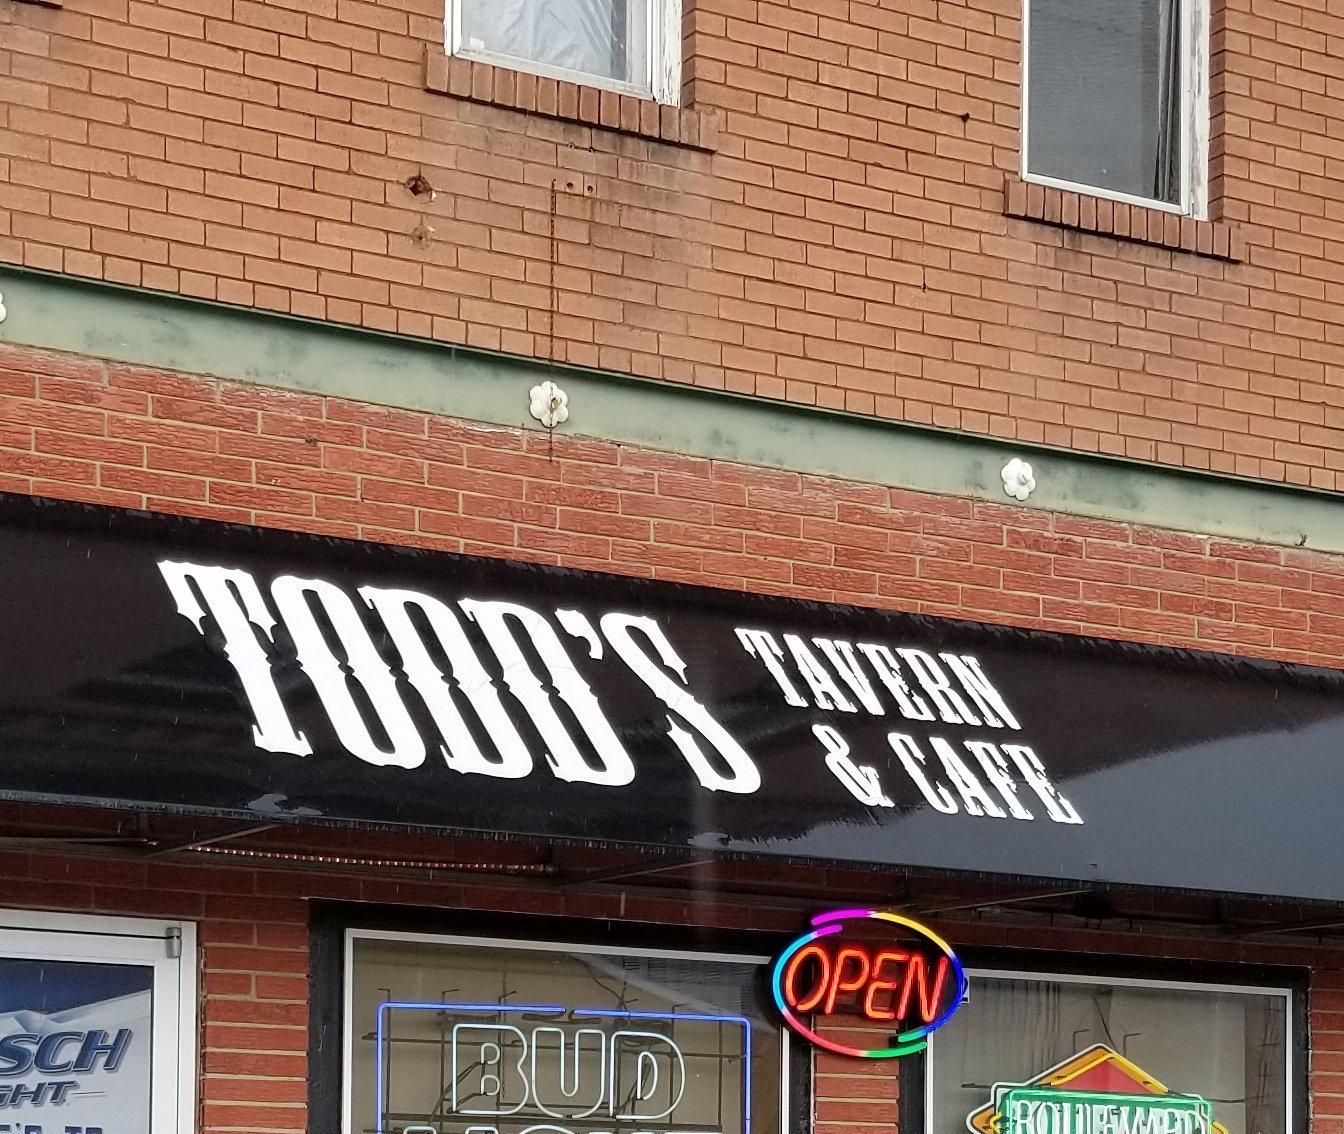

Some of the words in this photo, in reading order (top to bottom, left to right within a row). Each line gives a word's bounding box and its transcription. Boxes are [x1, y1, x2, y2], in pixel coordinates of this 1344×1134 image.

[157, 559, 761, 793] TODD'S
[735, 626, 1022, 731] TAVERN
[811, 725, 892, 808] &
[889, 732, 1084, 825] CAFE
[785, 945, 947, 1023] OPEN
[453, 1024, 685, 1119] BUD
